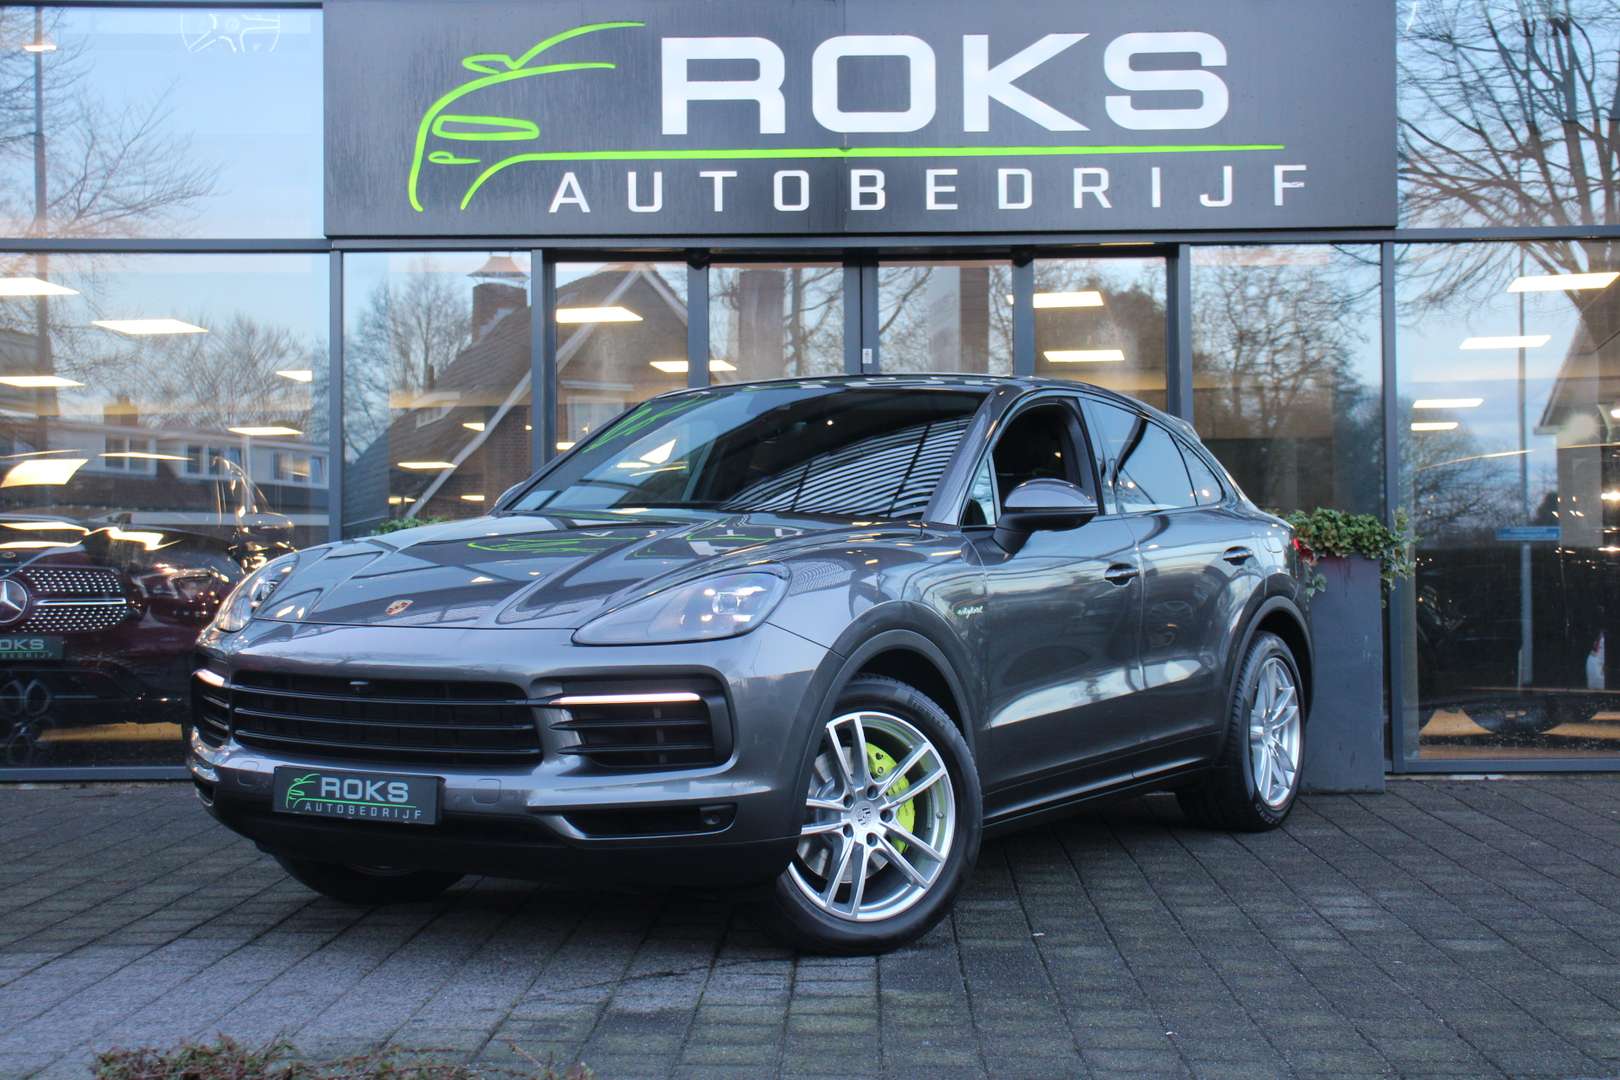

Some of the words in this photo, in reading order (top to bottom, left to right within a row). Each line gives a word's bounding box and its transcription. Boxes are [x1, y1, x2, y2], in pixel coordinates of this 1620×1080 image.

[661, 32, 1229, 135] ROKS
[548, 164, 1307, 213] AUTOBEDRIJF
[320, 776, 409, 803] ROKS
[304, 802, 422, 819] AUTOBEDRIJF
